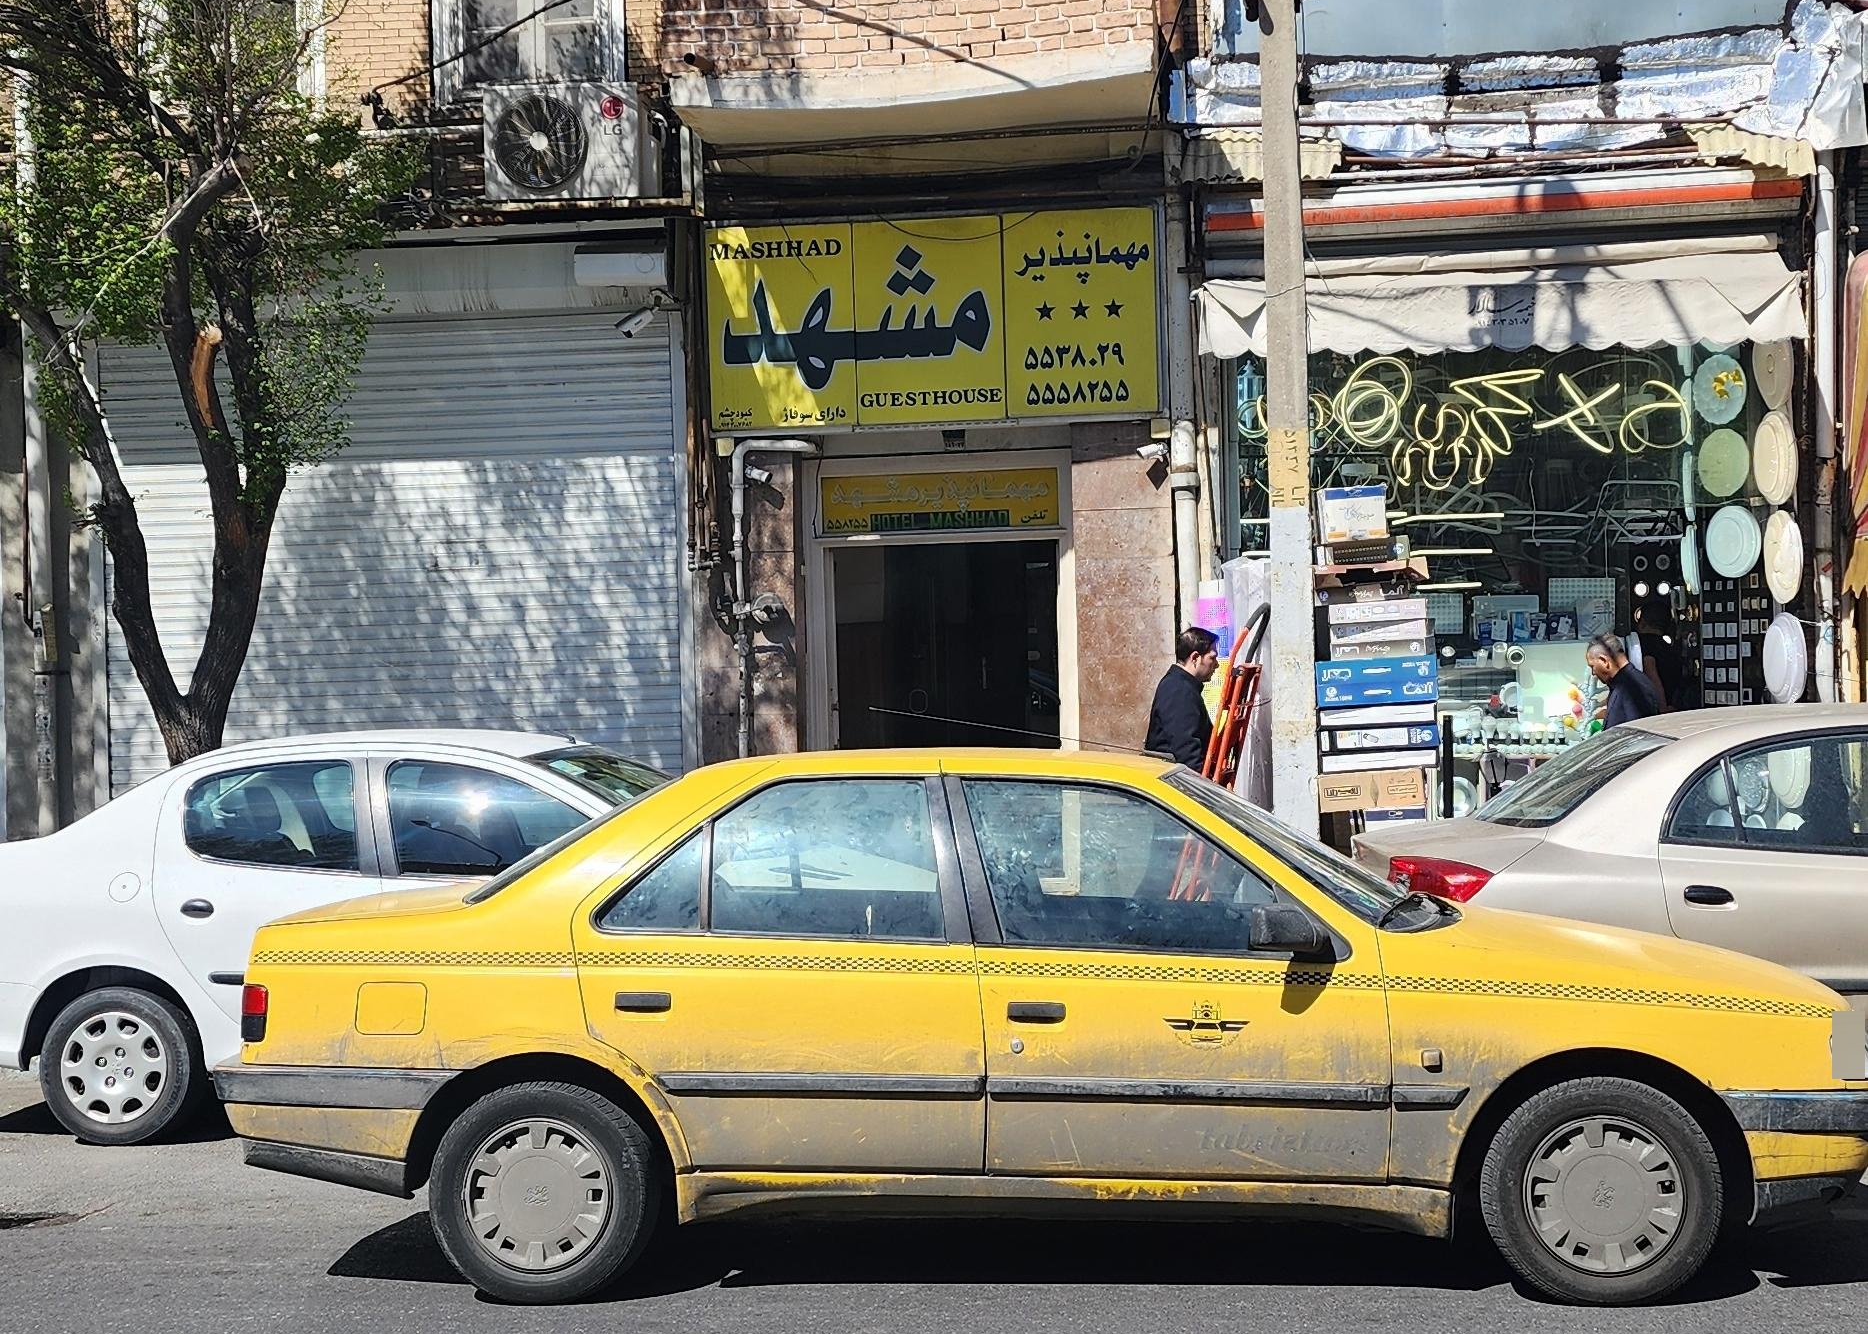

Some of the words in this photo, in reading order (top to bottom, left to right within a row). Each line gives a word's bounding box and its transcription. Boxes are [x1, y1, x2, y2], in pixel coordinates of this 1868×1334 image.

[603, 123, 622, 136] LG
[708, 238, 842, 261] MASHHAD
[1014, 229, 1150, 285] مهمانپذیر
[722, 244, 992, 391] مشهد
[860, 387, 1004, 409] GUESTHOUSE
[1026, 379, 1130, 406] ۵۵۵۸۲۵۵
[814, 405, 847, 422] دارای
[871, 514, 919, 530] HOTEL
[929, 510, 1008, 529] MASHHAD
[1020, 509, 1048, 524] تلفن
